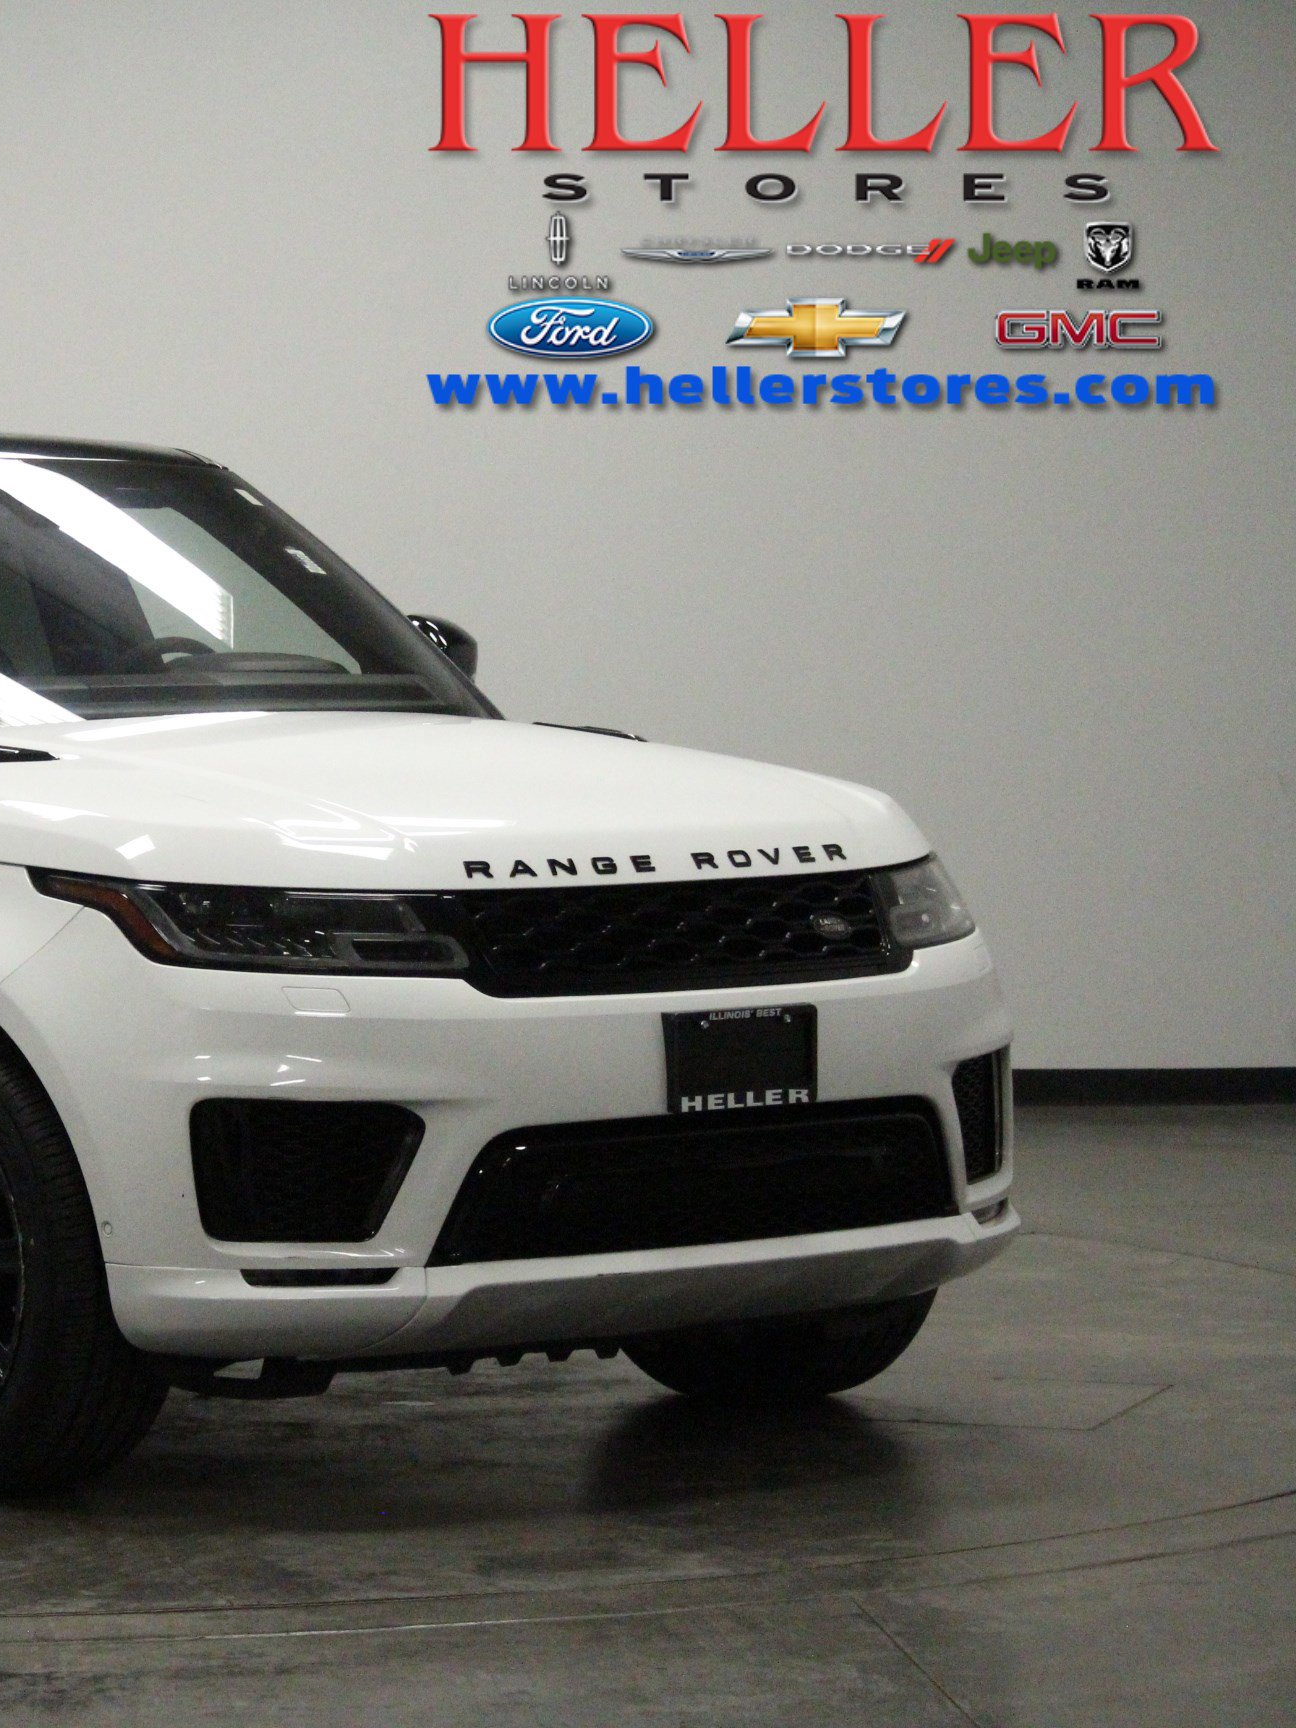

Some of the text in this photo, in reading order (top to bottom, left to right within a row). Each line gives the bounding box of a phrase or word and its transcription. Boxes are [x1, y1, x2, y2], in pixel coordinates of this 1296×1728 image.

[462, 842, 848, 880] RANGE ROVER
[755, 1007, 783, 1018] BEST
[680, 1088, 810, 1113] HELLER
